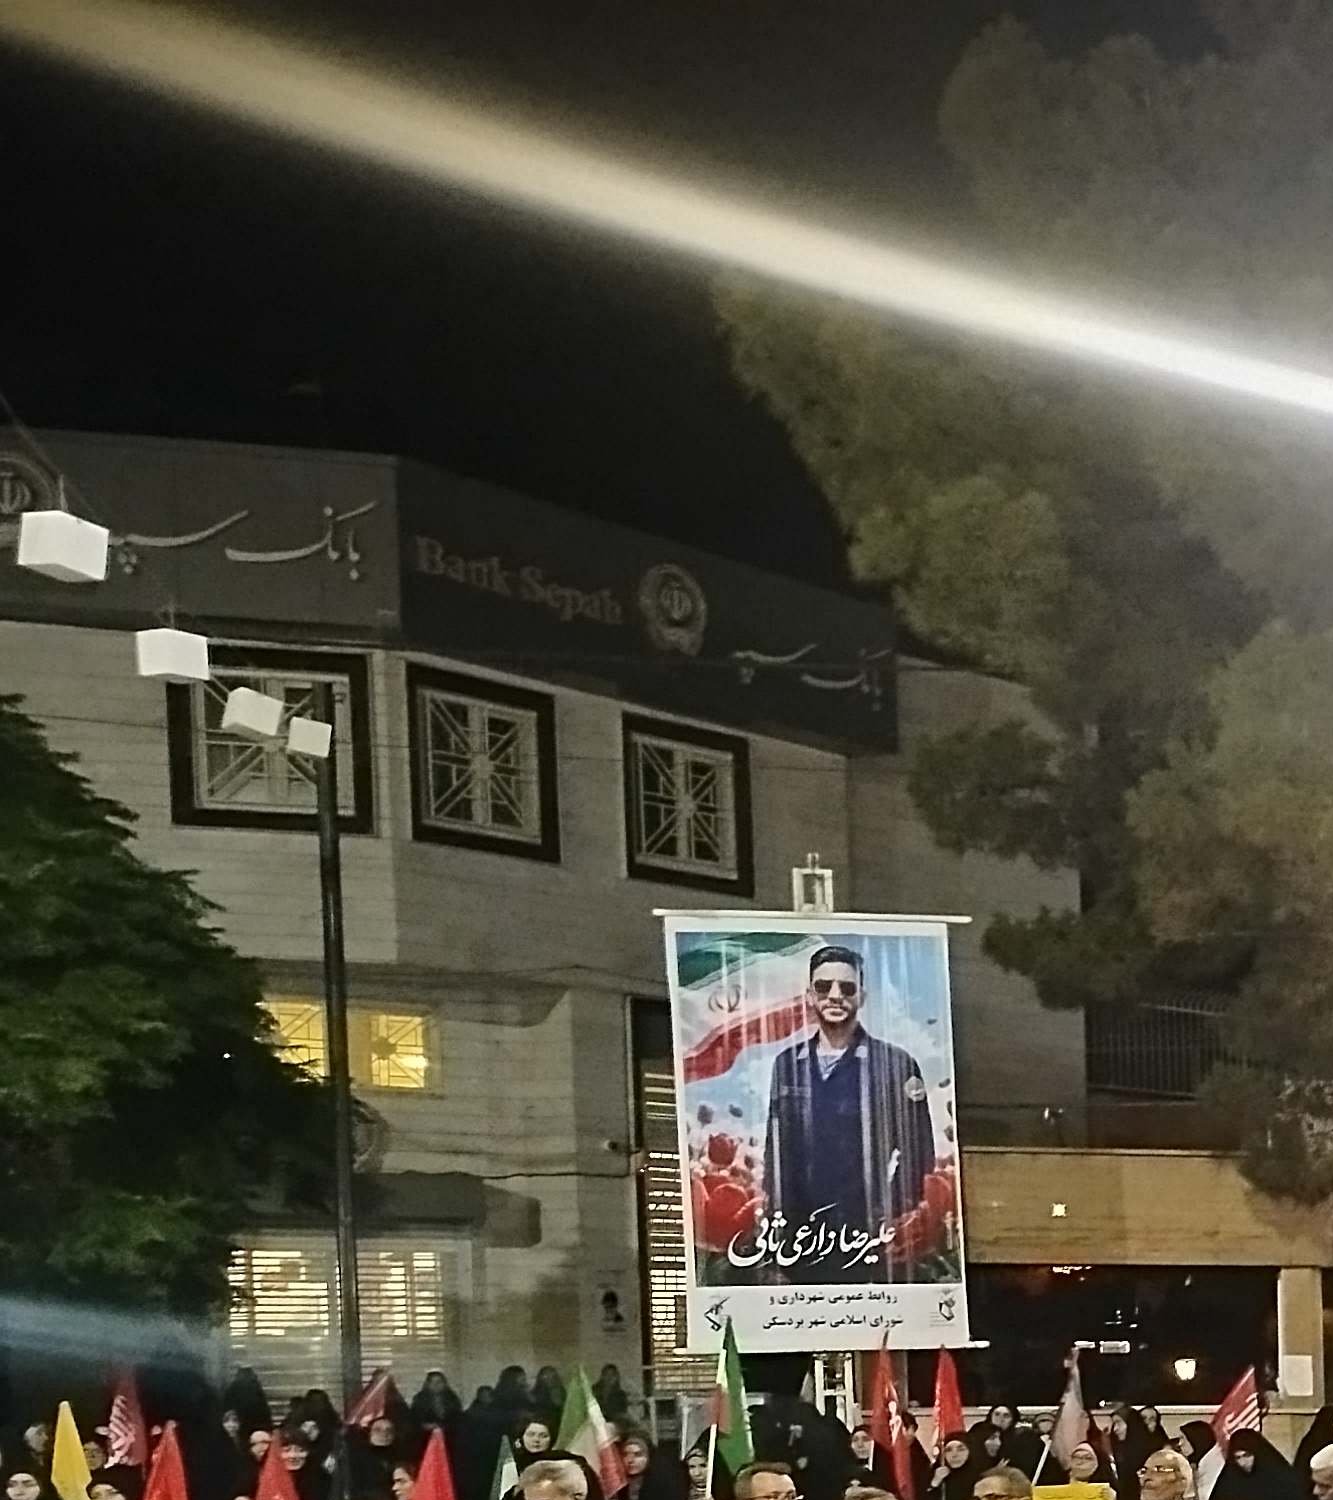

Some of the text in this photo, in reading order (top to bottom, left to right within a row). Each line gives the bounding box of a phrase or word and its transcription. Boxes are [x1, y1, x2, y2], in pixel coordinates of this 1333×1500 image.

[226, 501, 378, 581] بانک
[415, 535, 625, 626] Bank Sepah
[728, 1208, 897, 1269] علیرضا زارعی ثانی
[769, 1291, 898, 1305] روابط عمومی شهرداری و
[763, 1316, 804, 1330] بردسکن
[807, 1315, 826, 1329] شهر
[830, 1314, 866, 1328] اسلامی
[869, 1314, 904, 1328] شورای
